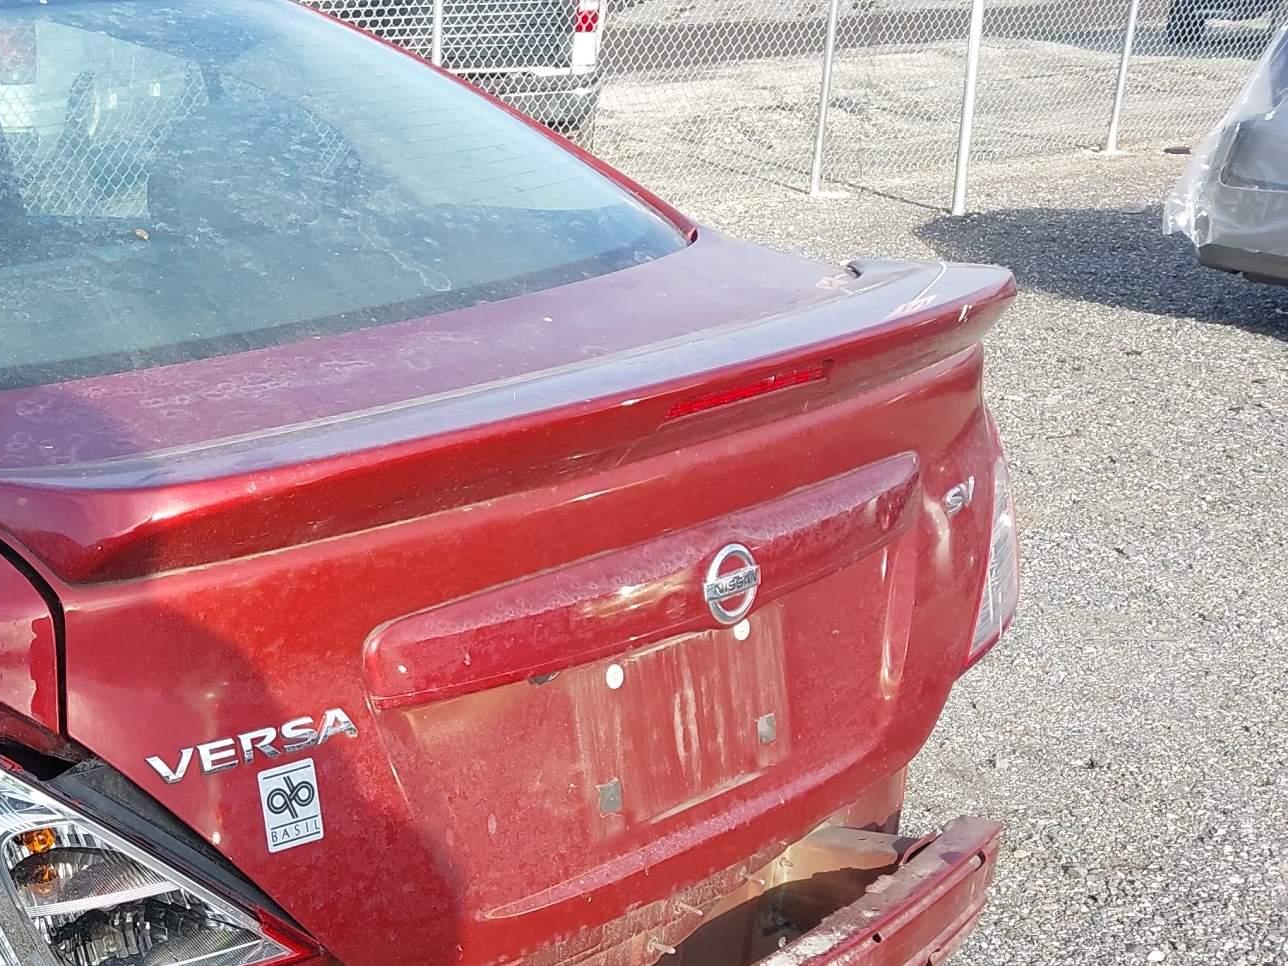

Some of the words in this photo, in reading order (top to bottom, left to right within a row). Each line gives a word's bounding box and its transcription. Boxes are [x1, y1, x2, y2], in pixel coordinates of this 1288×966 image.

[713, 568, 758, 595] NISSAN
[144, 707, 359, 785] VERSA
[270, 819, 321, 843] BASIL
